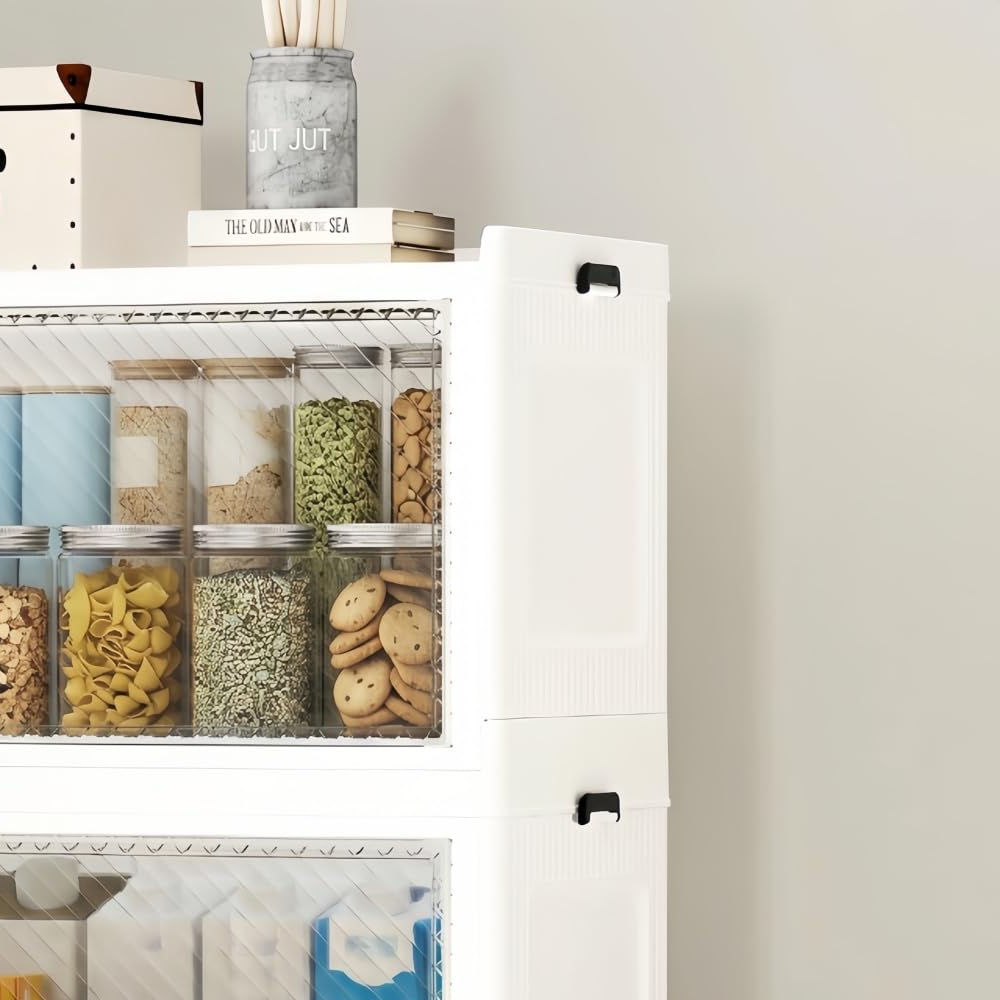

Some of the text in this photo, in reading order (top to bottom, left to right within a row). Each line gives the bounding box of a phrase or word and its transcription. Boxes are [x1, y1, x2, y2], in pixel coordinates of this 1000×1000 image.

[288, 127, 332, 151] JUT
[224, 218, 248, 235] THE
[249, 218, 272, 234] OLD
[273, 218, 298, 234] MAN
[329, 216, 350, 233] SEA
